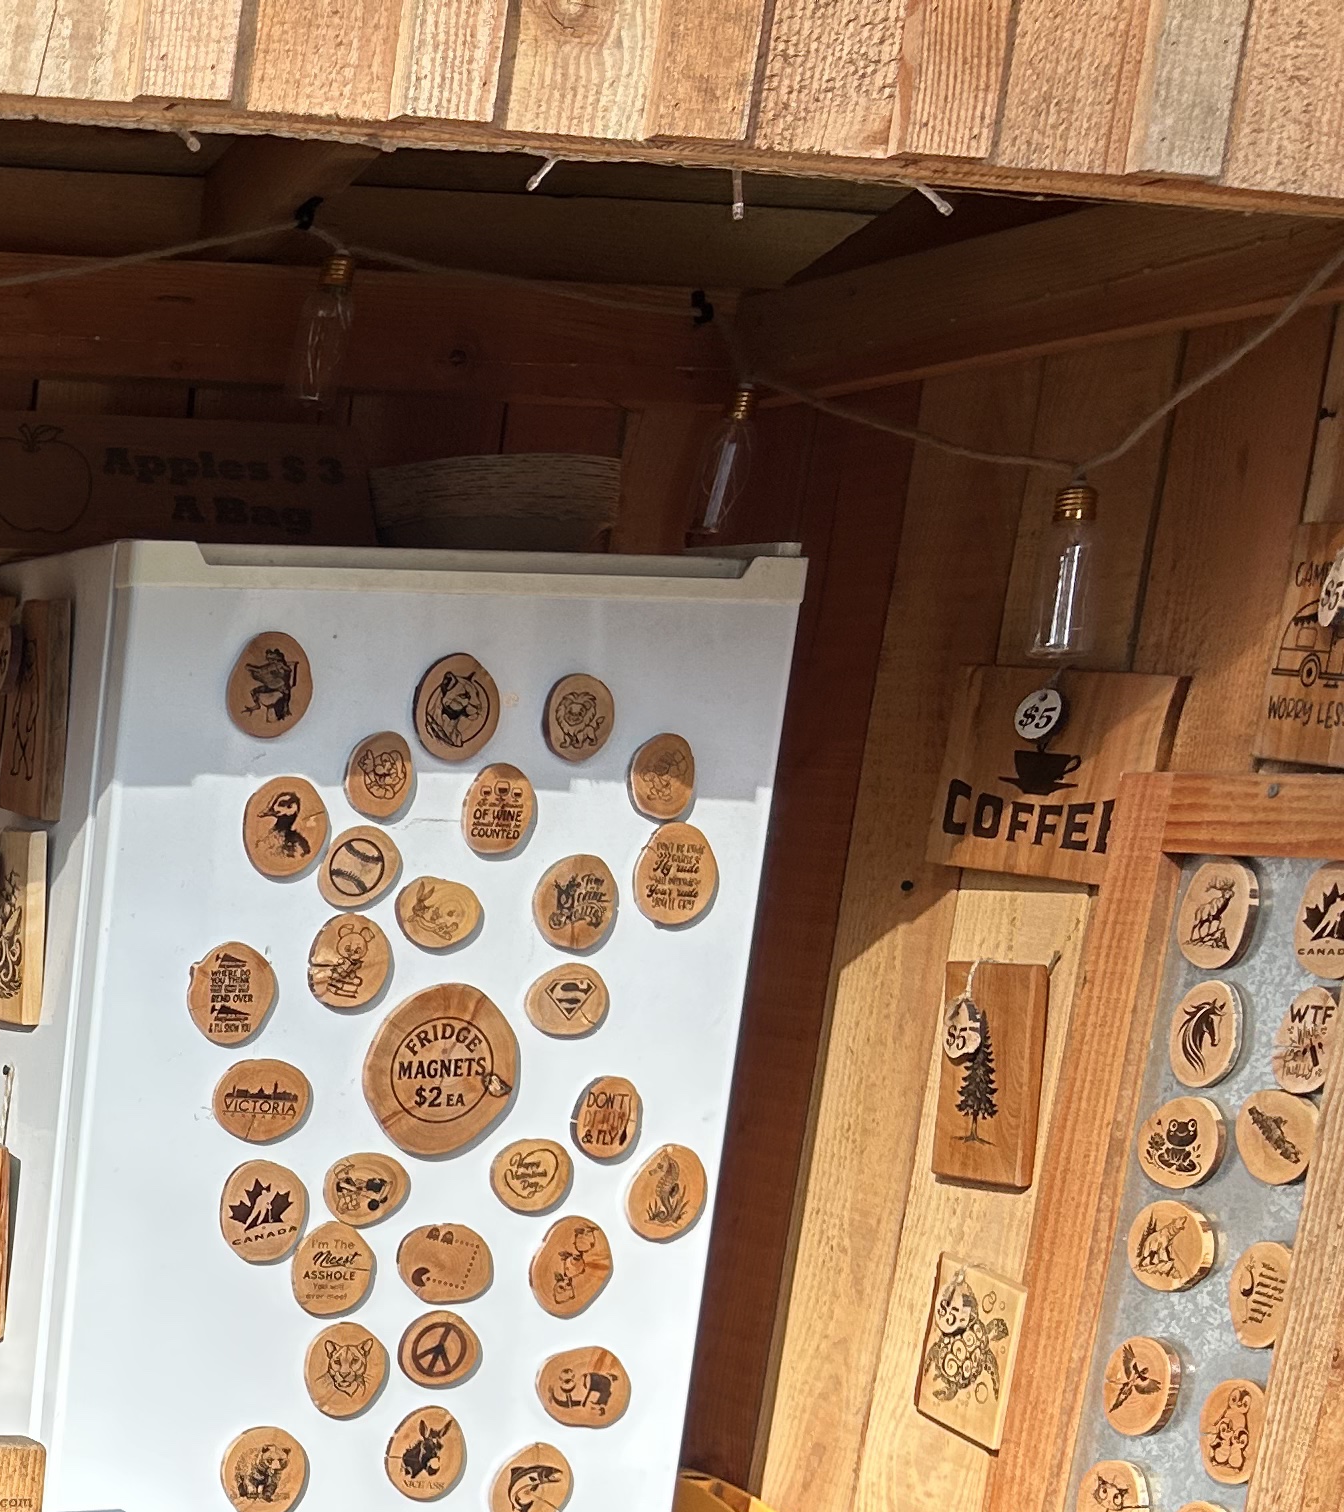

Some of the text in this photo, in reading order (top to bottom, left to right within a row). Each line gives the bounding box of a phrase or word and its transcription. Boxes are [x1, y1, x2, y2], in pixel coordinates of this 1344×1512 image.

[102, 446, 271, 486] Apples
[171, 494, 313, 535] A Bag
[1018, 705, 1054, 729] $5
[1268, 696, 1313, 726] WORRY
[473, 808, 523, 823] OF WINE
[471, 827, 520, 840] COUNTED
[233, 994, 254, 1003] OVER
[1291, 1004, 1335, 1025] WTF
[405, 1021, 481, 1059] FRIDGE
[946, 1025, 967, 1049] $5
[397, 1056, 486, 1080] MAGNETS
[224, 1098, 296, 1116] VICTORIA
[413, 1087, 466, 1108] $2 EA
[596, 1129, 619, 1145] FLY
[232, 1226, 297, 1246] CANADA
[333, 1238, 355, 1250] The
[312, 1250, 362, 1268] Nicest
[302, 1270, 356, 1281] ASSHOLE
[937, 1300, 958, 1328] $5
[403, 1480, 445, 1490] NICE ASS
